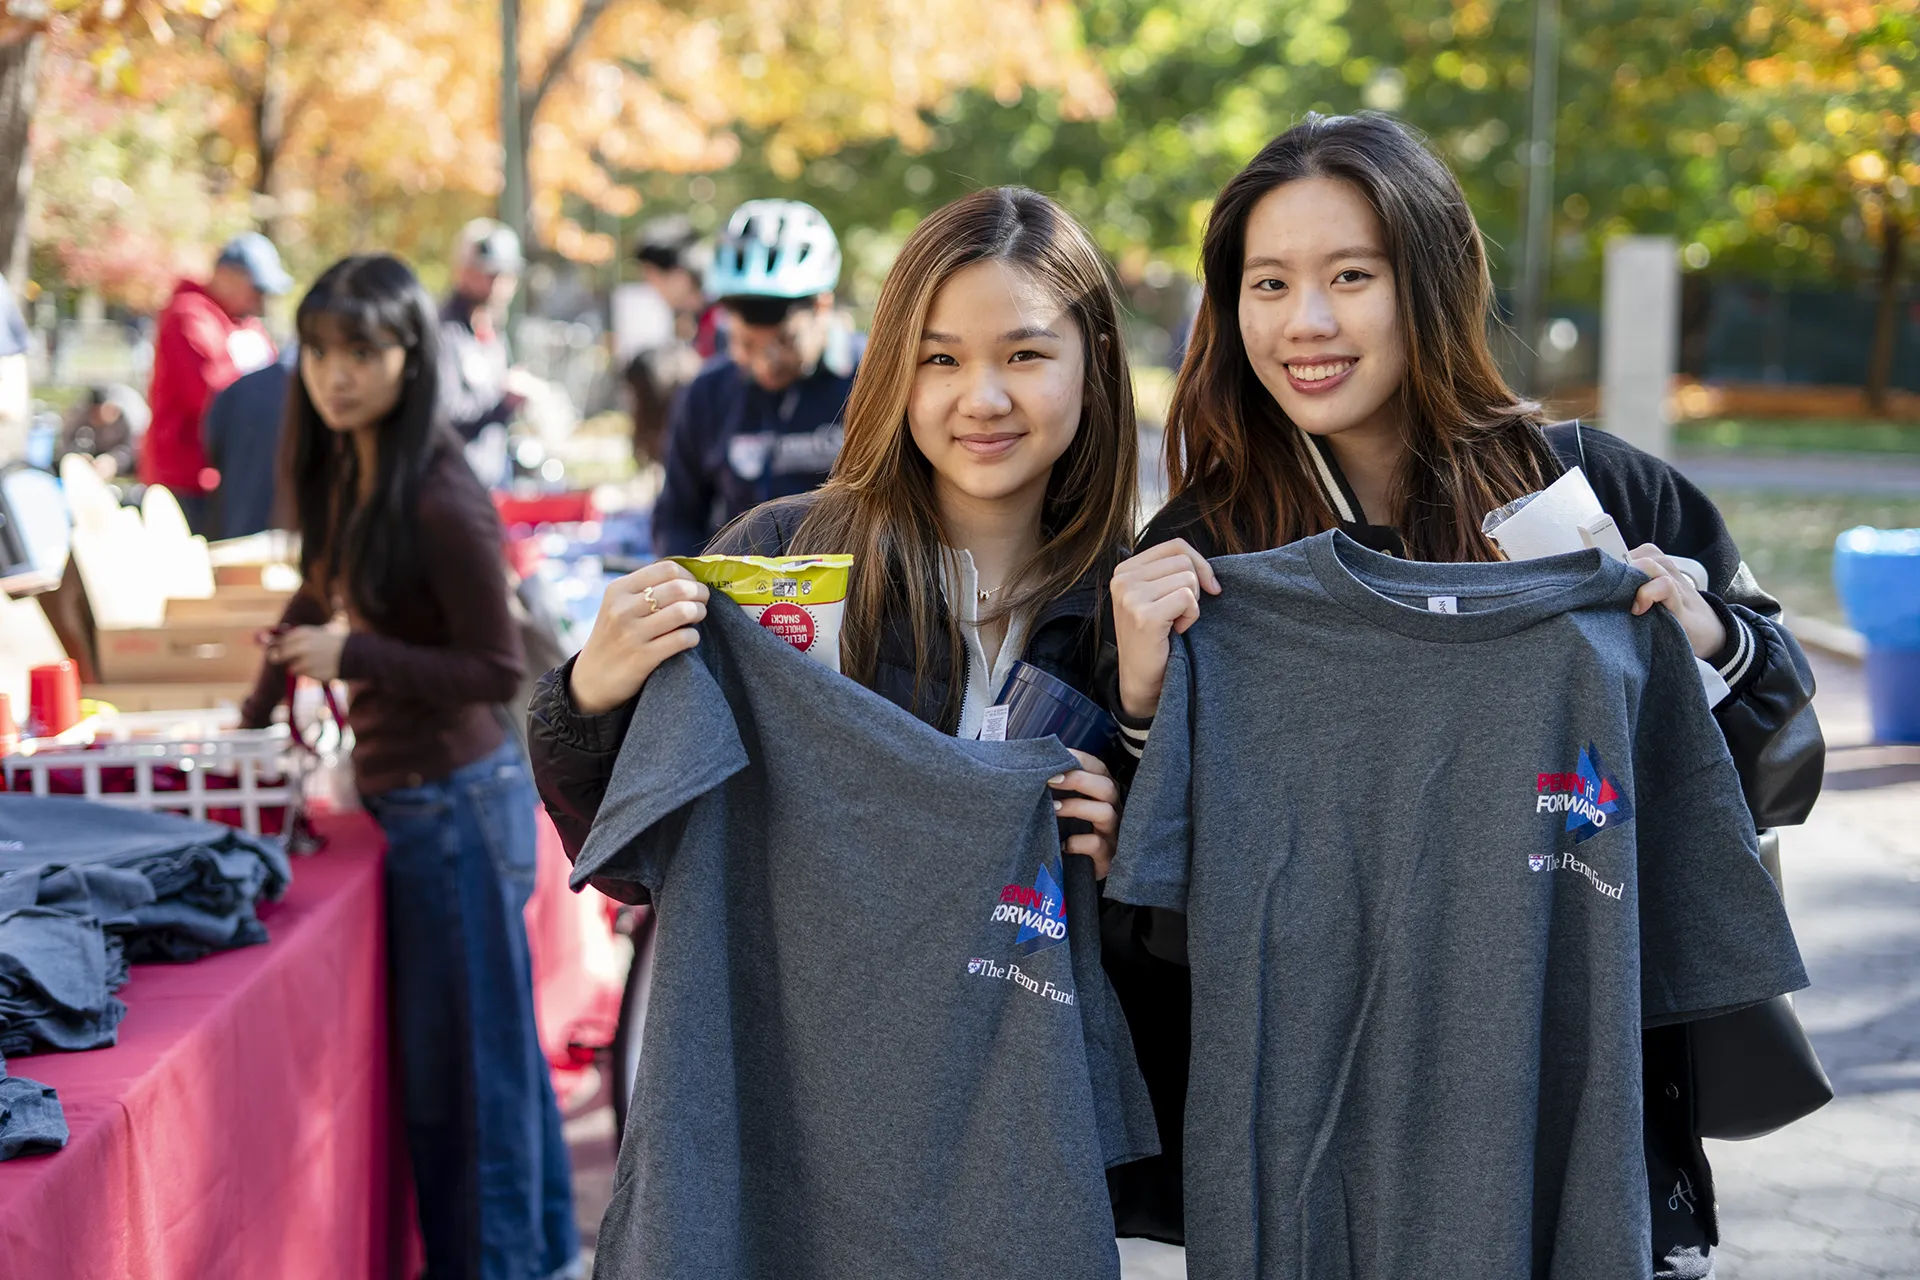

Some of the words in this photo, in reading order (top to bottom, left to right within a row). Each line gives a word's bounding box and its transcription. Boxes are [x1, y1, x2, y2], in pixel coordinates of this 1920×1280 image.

[771, 614, 800, 624] SNACK!
[785, 625, 808, 634] WHOLE
[1537, 772, 1585, 794] PENN
[1585, 781, 1595, 801] it
[1536, 794, 1608, 828] FORWARD
[1544, 853, 1560, 872] The
[1562, 852, 1592, 882] Penn
[1592, 869, 1625, 900] Fund
[1041, 896, 1055, 915] it
[990, 904, 1066, 940] FORWARD
[981, 959, 1005, 979] The
[1006, 964, 1039, 994] Penn
[1040, 981, 1074, 1006] Fund
